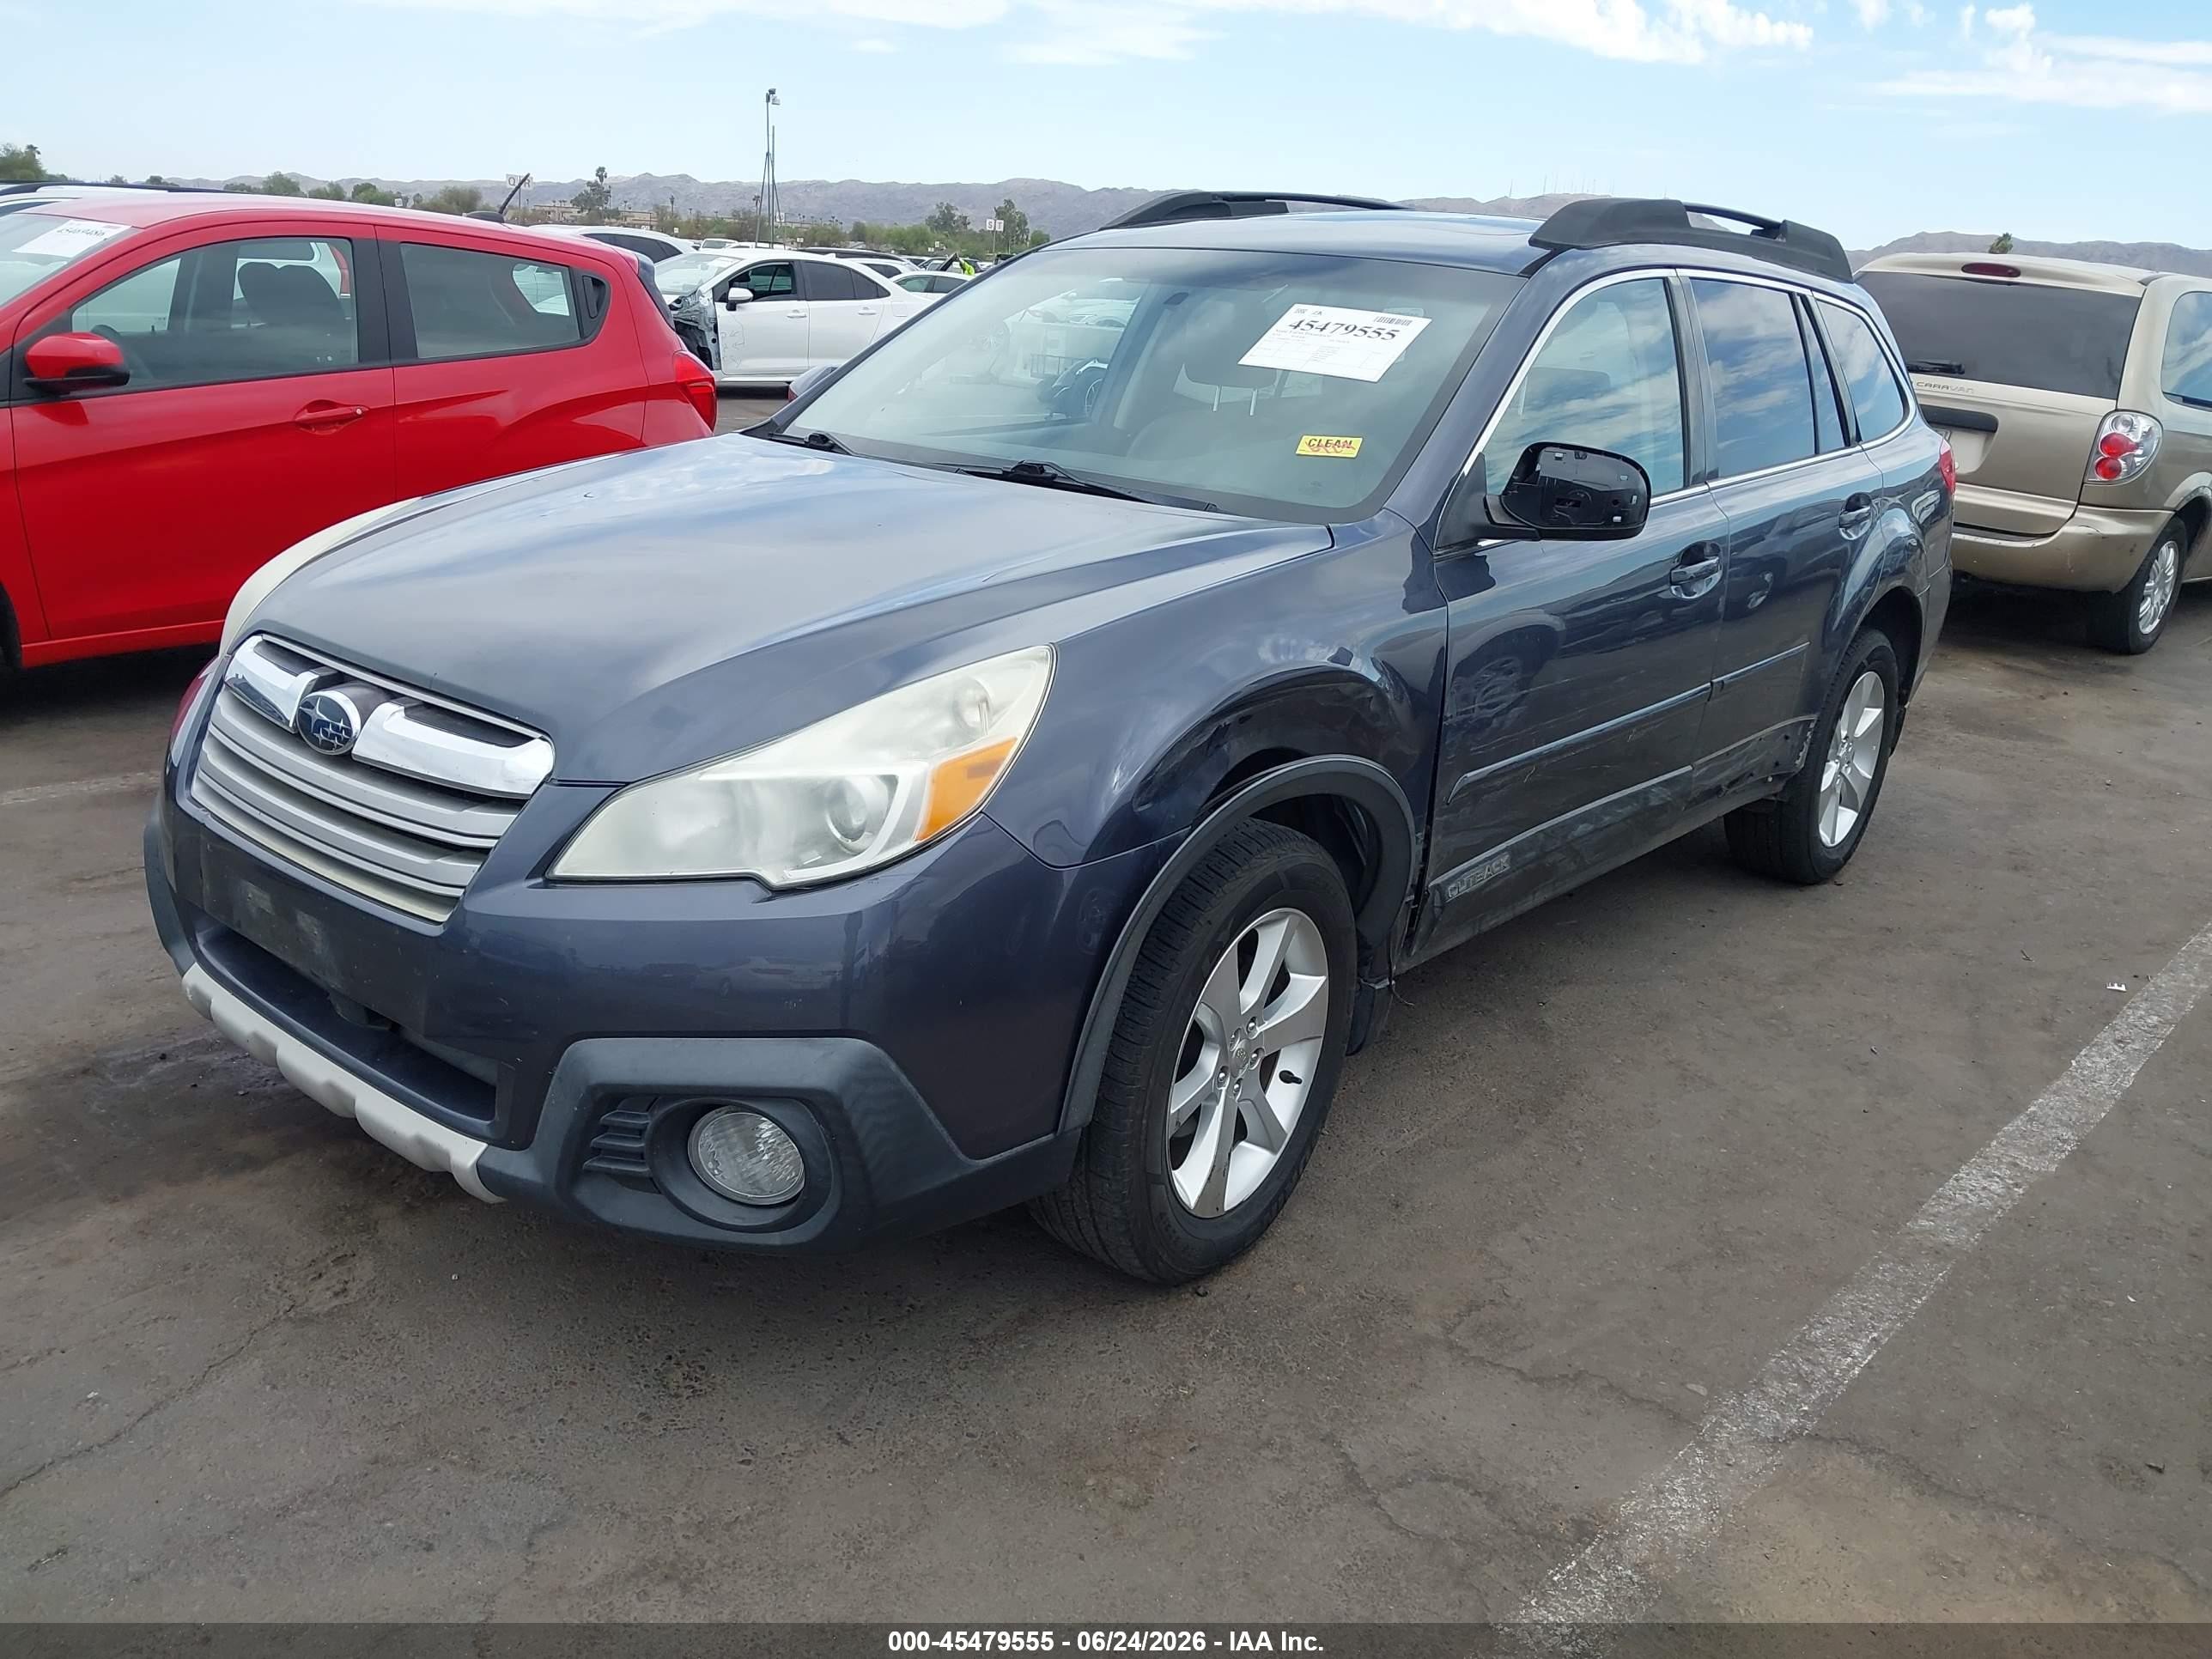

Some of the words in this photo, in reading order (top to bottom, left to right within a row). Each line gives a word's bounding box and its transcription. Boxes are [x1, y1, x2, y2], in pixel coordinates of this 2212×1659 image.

[508, 177, 516, 186] Q
[988, 221, 994, 229] S
[997, 222, 1003, 230] T
[1289, 319, 1400, 341] 45479555
[1916, 381, 1974, 394] CARAVAN
[1308, 438, 1353, 448] CLEAN
